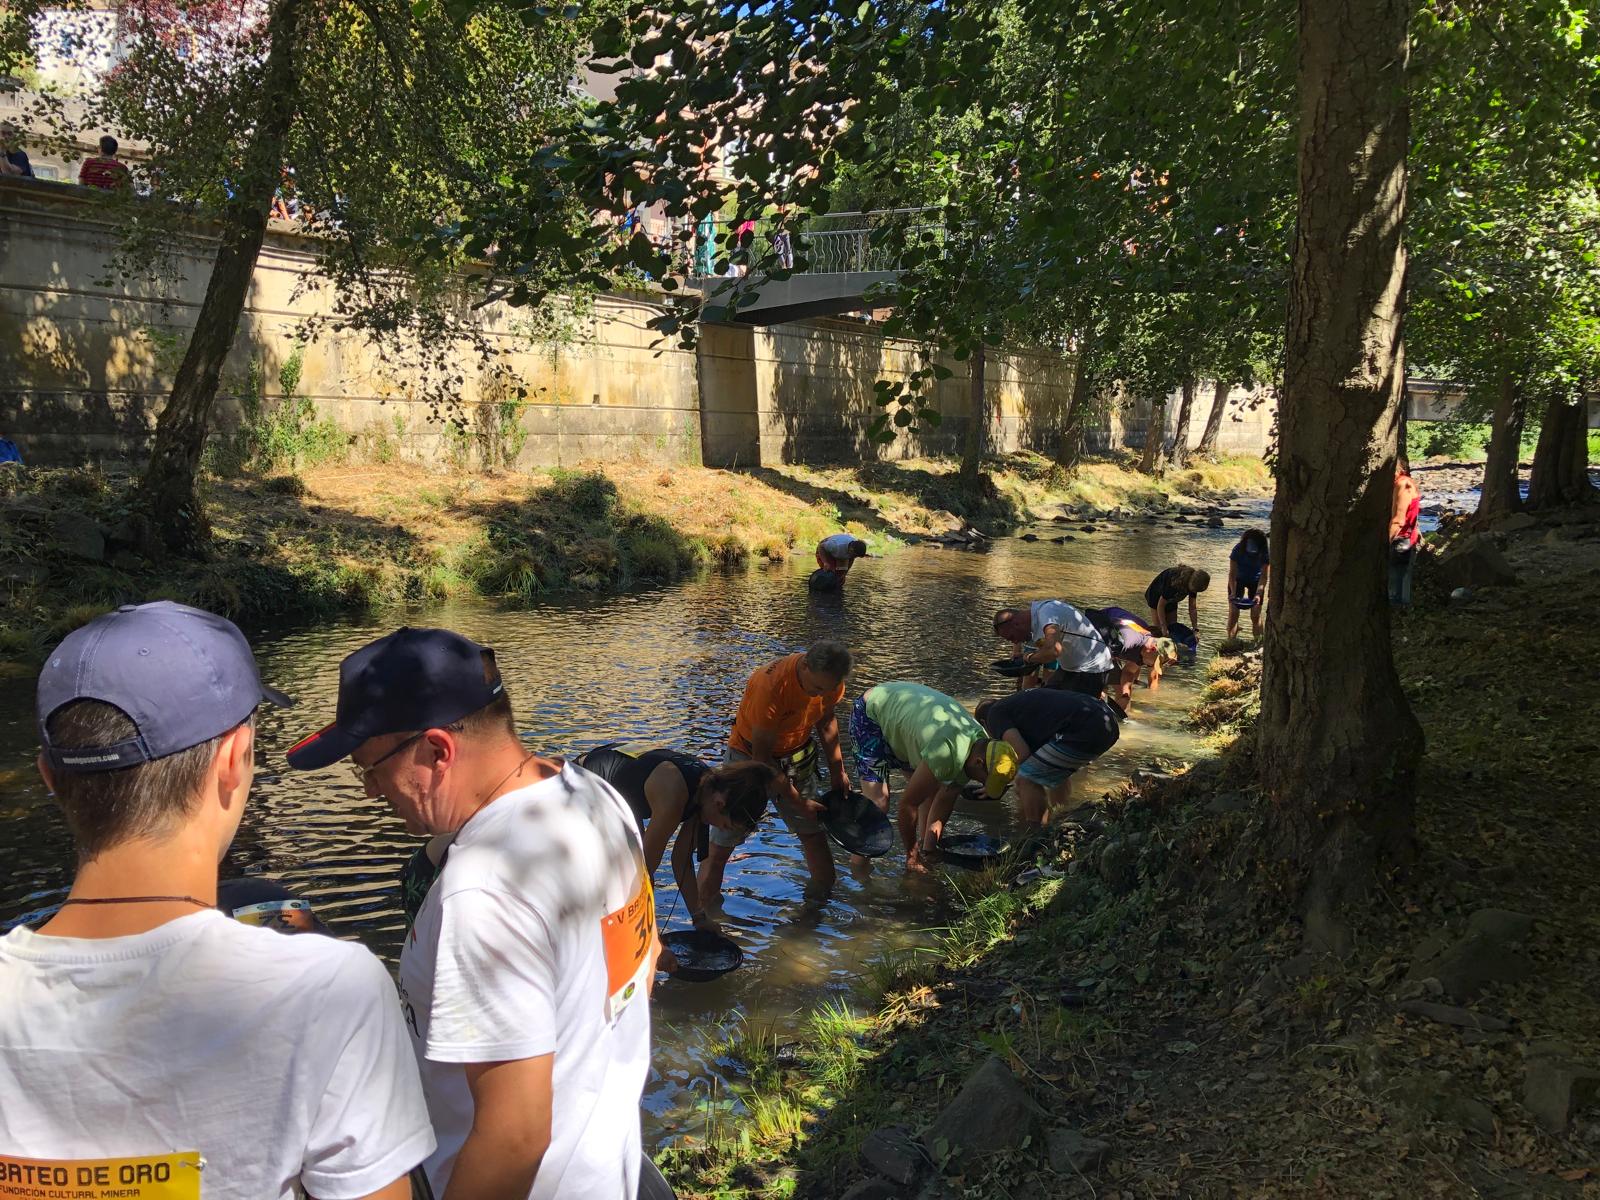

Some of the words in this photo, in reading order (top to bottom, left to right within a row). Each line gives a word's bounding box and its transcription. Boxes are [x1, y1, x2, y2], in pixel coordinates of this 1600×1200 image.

[0, 1162, 68, 1186] BATEO
[76, 1167, 109, 1186] DE
[119, 1163, 170, 1185] ORO
[48, 1190, 97, 1199] CULTURAL
[101, 1189, 140, 1198] MINERA
